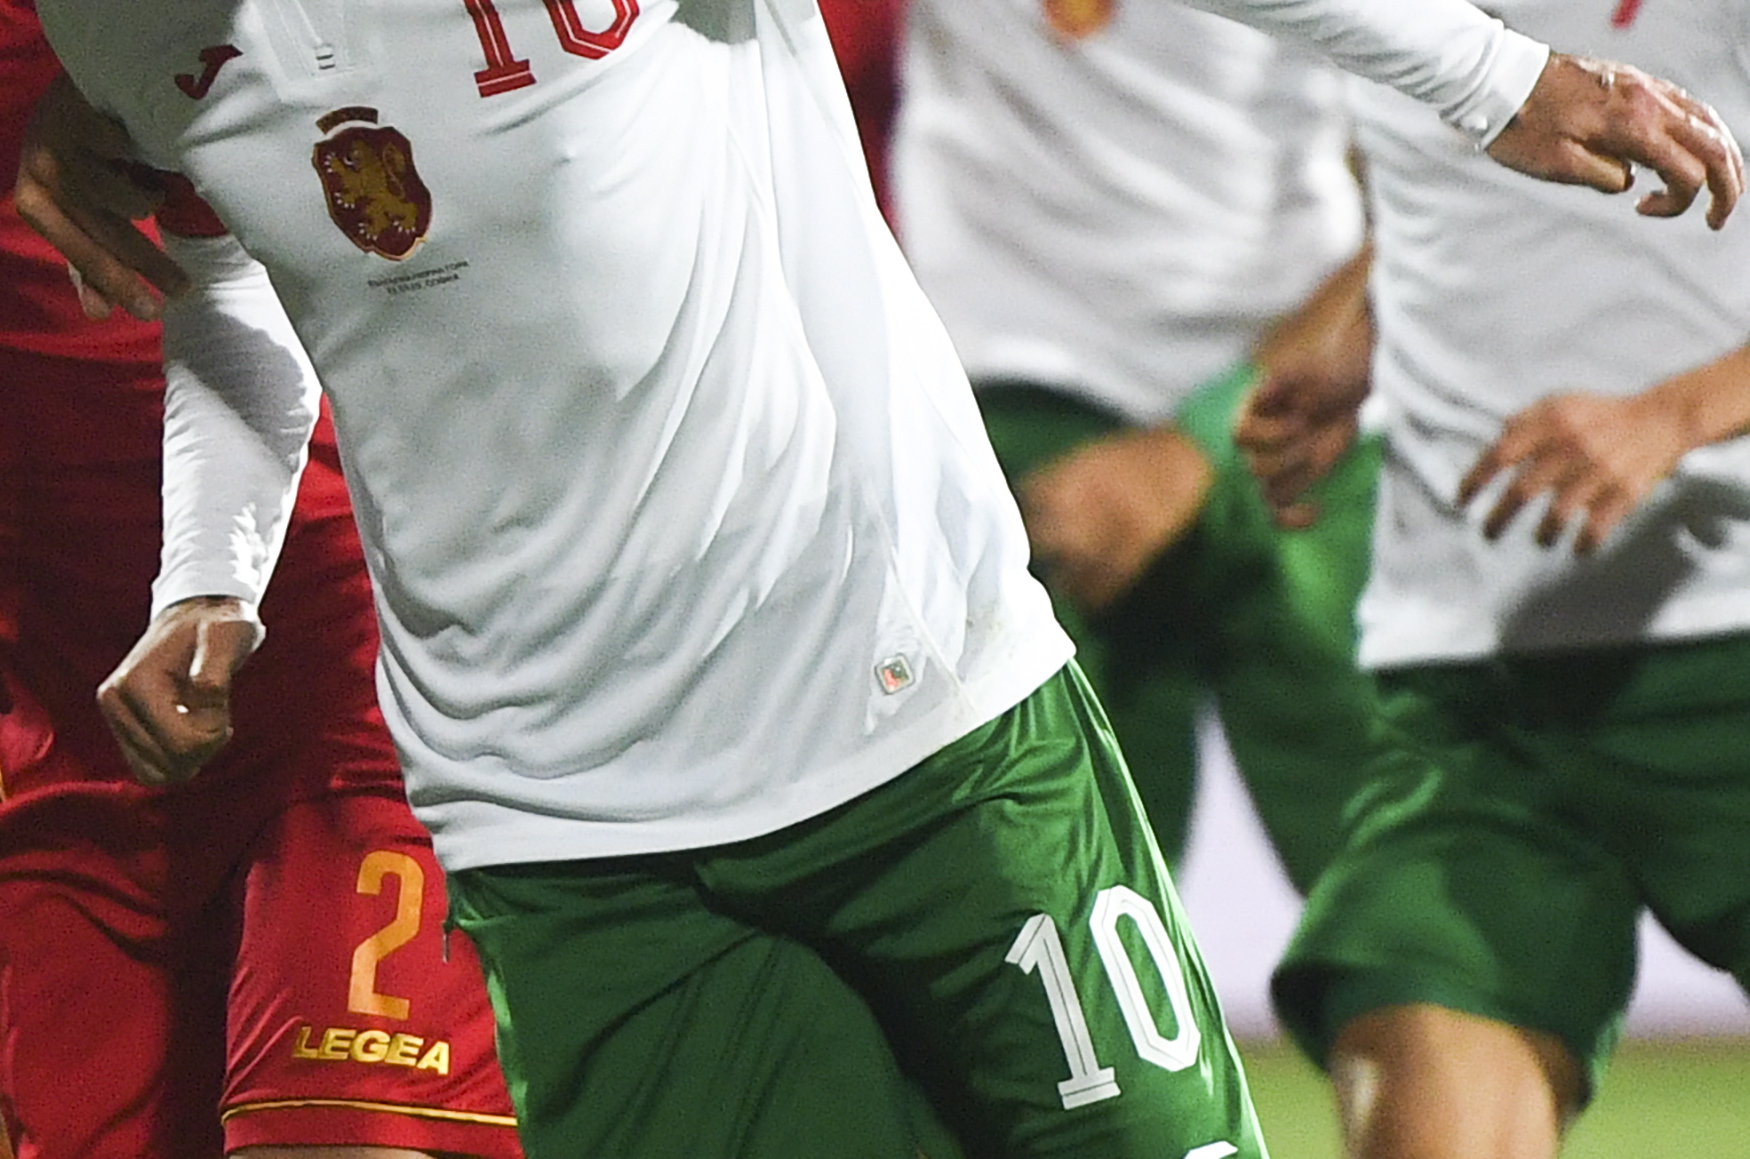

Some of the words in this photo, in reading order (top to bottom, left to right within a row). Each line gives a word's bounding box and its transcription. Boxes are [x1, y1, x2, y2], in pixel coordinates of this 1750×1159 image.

[347, 850, 425, 1022] 2
[1004, 884, 1202, 1111] 10
[292, 1026, 451, 1076] LEGEA
